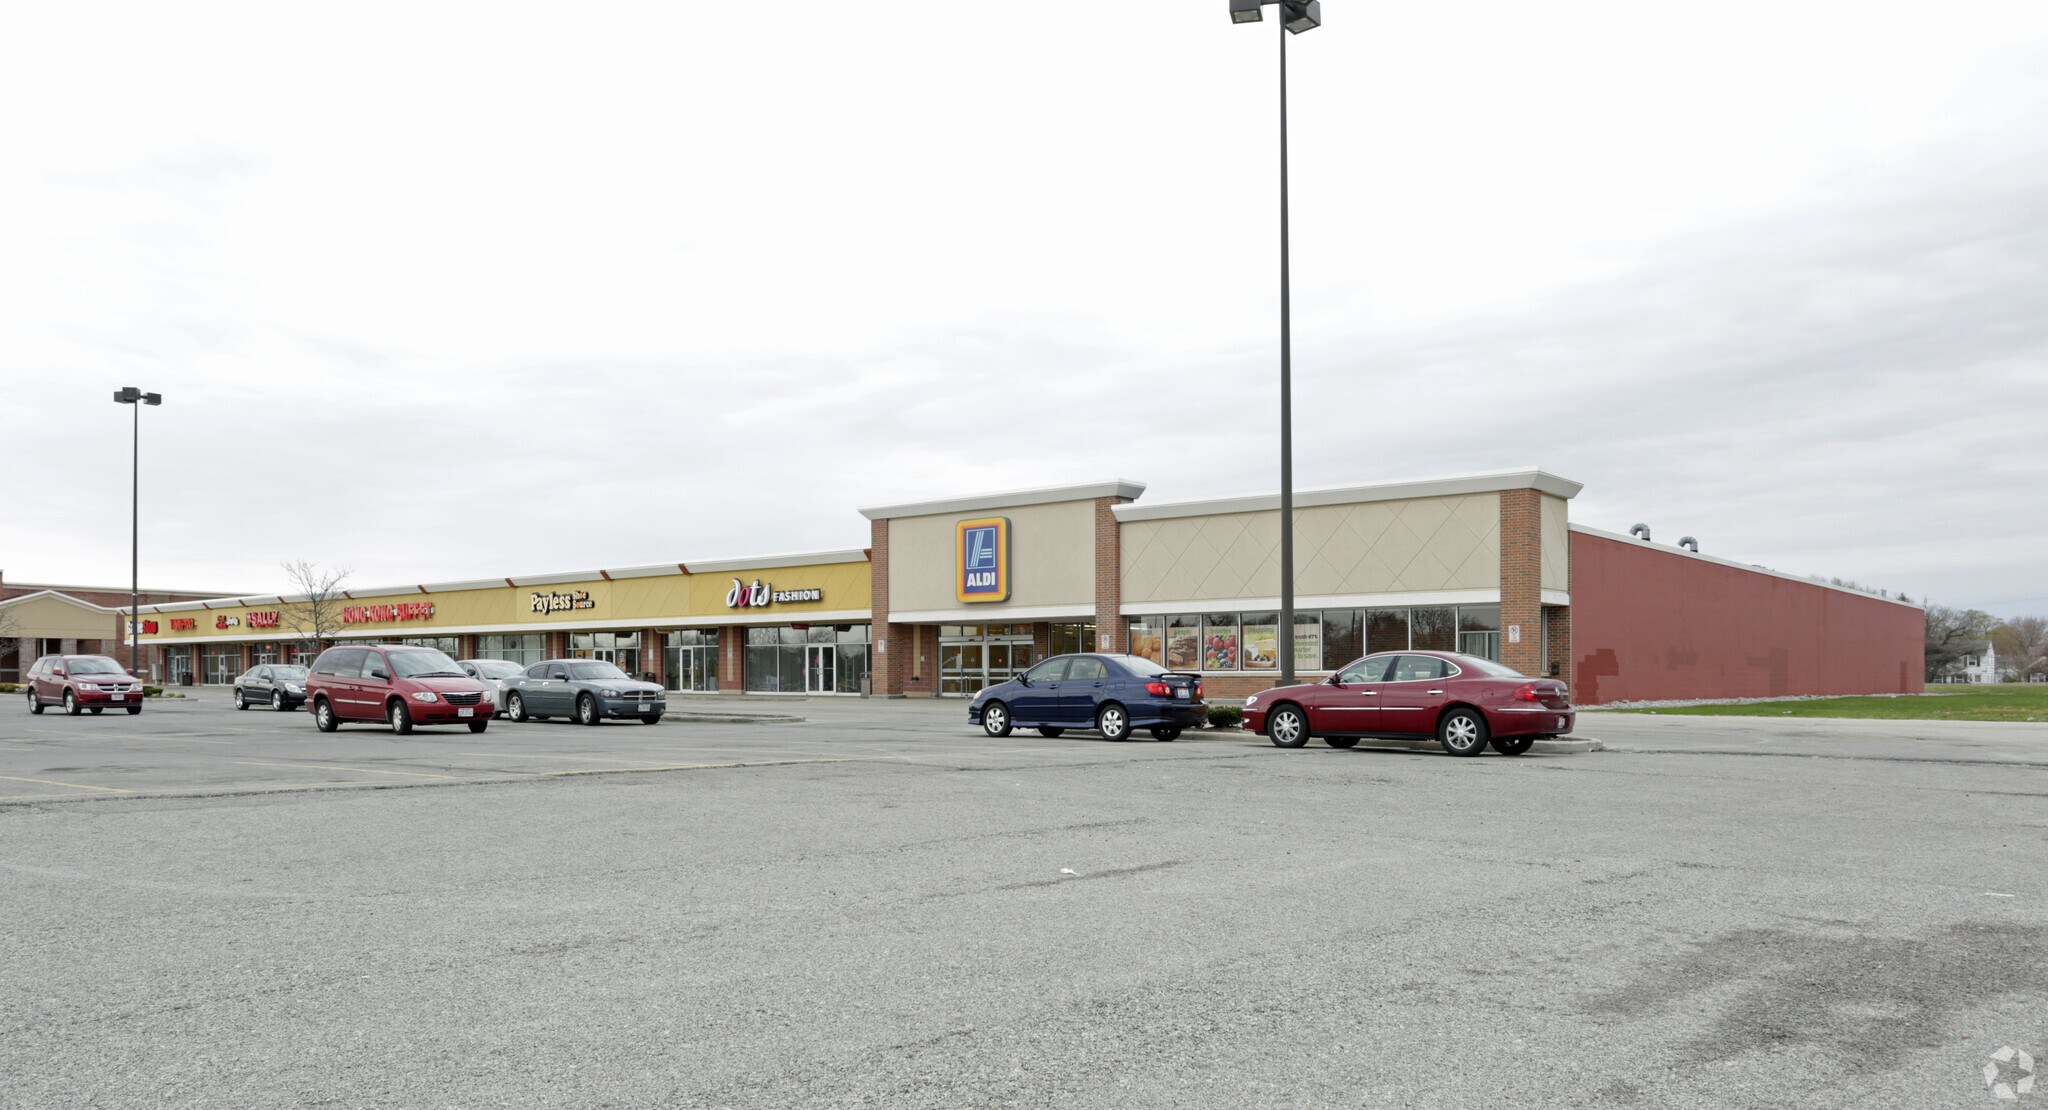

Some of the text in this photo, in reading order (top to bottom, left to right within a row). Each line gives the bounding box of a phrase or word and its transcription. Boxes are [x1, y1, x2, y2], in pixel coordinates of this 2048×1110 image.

[967, 572, 996, 587] ALDI
[530, 592, 572, 614] Payless
[726, 578, 820, 608] dots FASHION
[251, 610, 279, 625] SALLY
[343, 602, 432, 623] HONG KONG BUFFET
